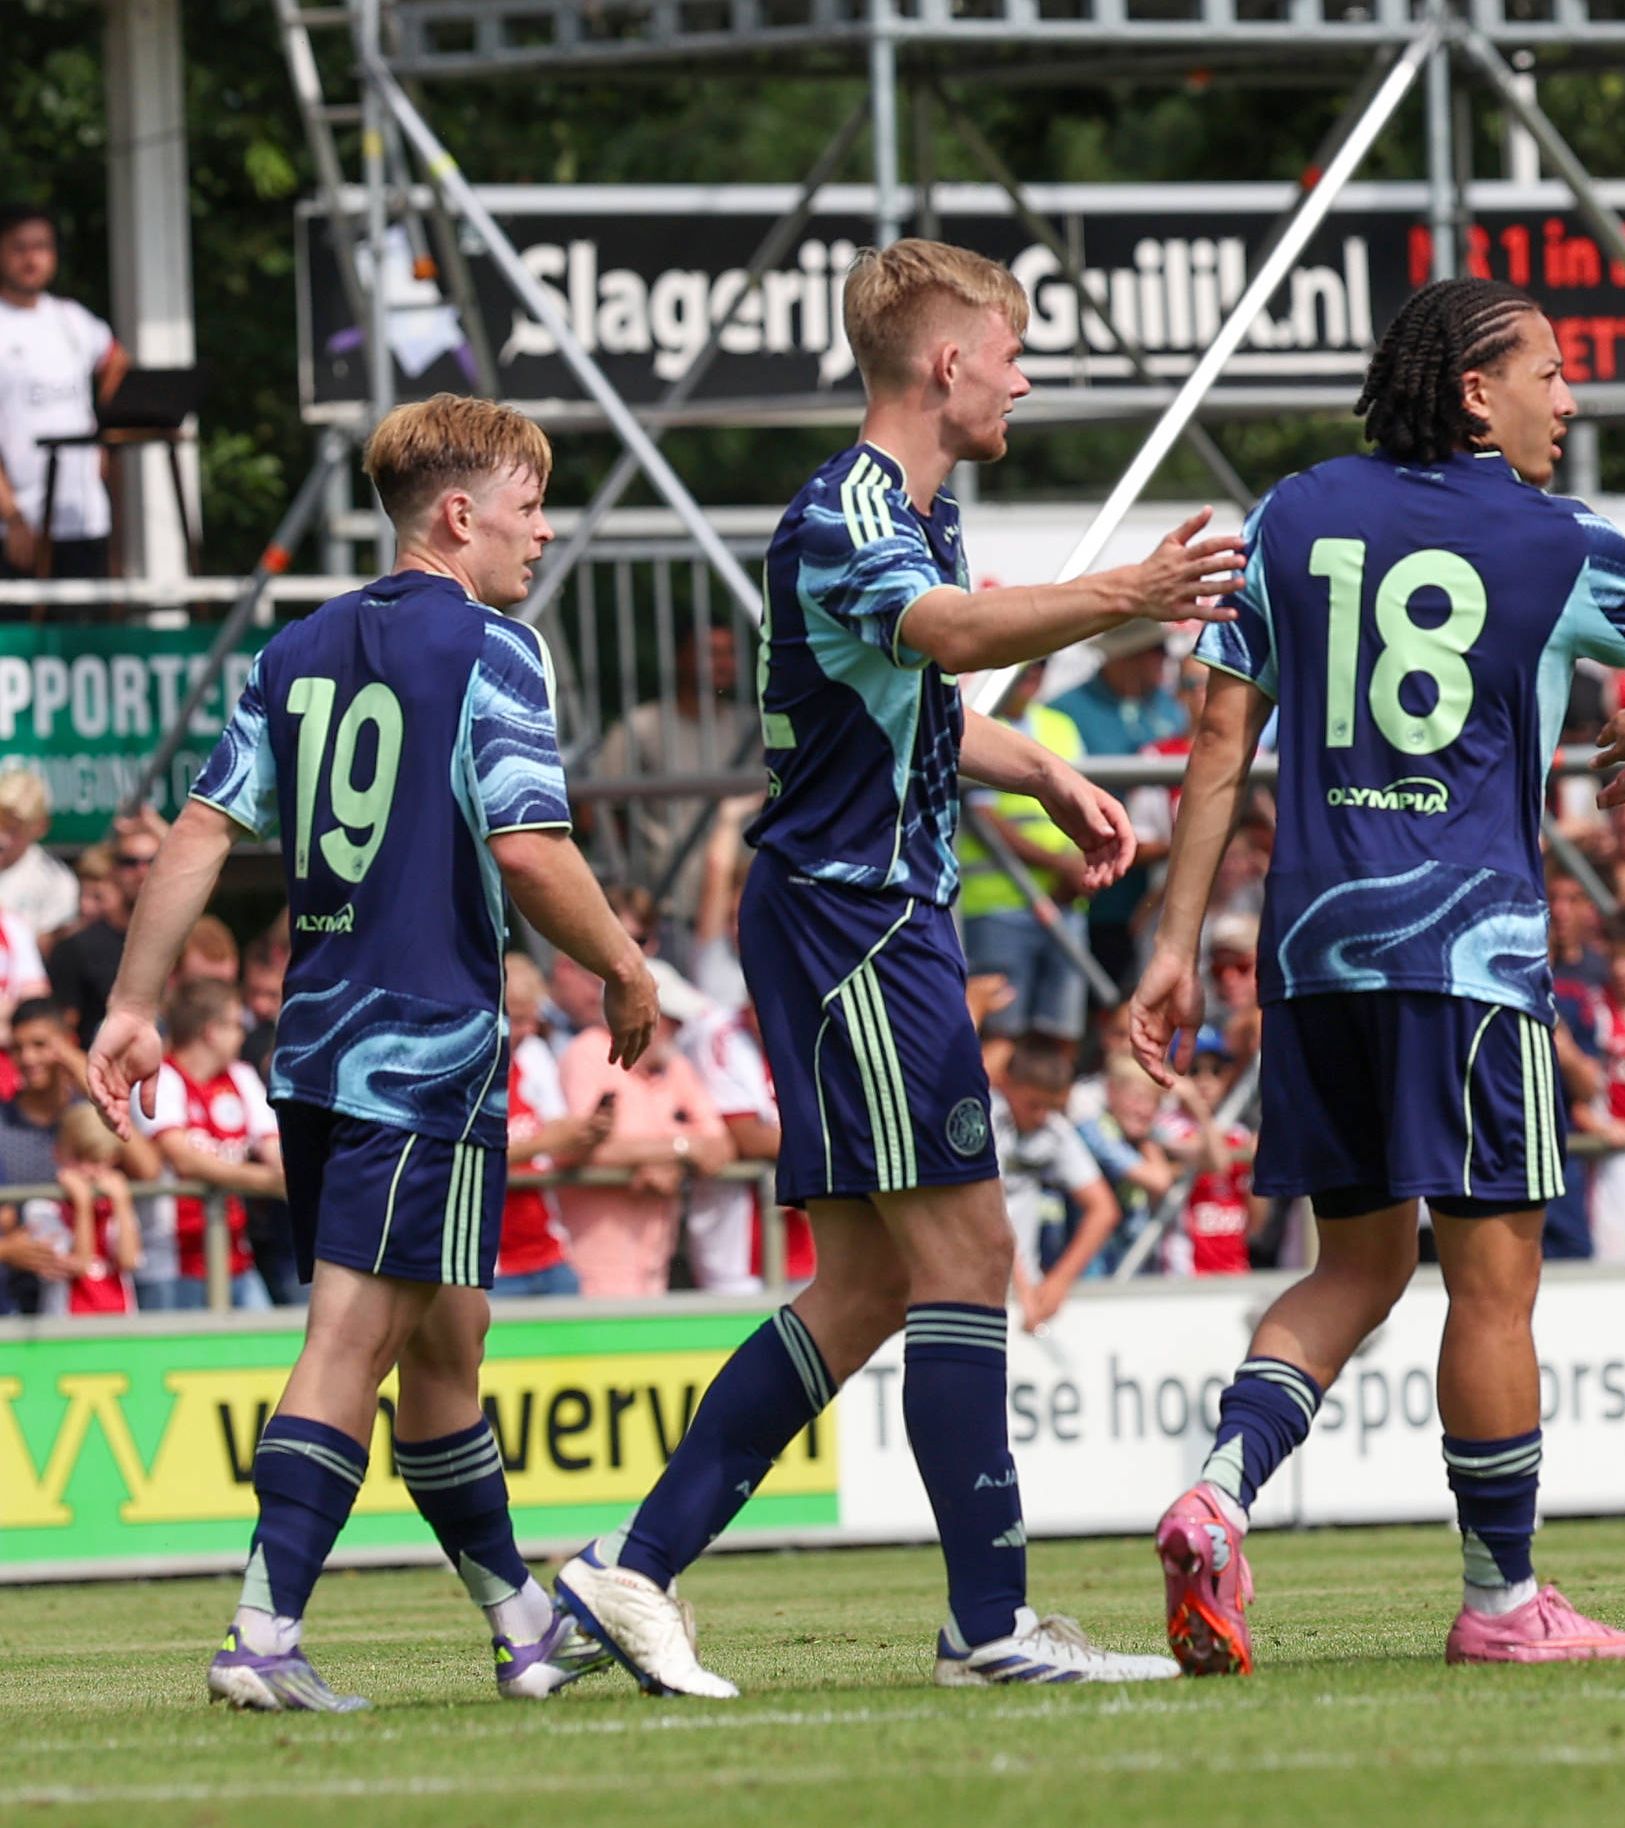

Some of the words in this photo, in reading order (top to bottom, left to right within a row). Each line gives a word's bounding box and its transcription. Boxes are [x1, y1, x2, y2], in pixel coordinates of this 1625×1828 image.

[502, 238, 868, 386] Slagerij
[1543, 217, 1600, 288] in
[1308, 537, 1488, 756] 18
[286, 676, 404, 884] 19
[1327, 783, 1449, 816] OLYMPIA
